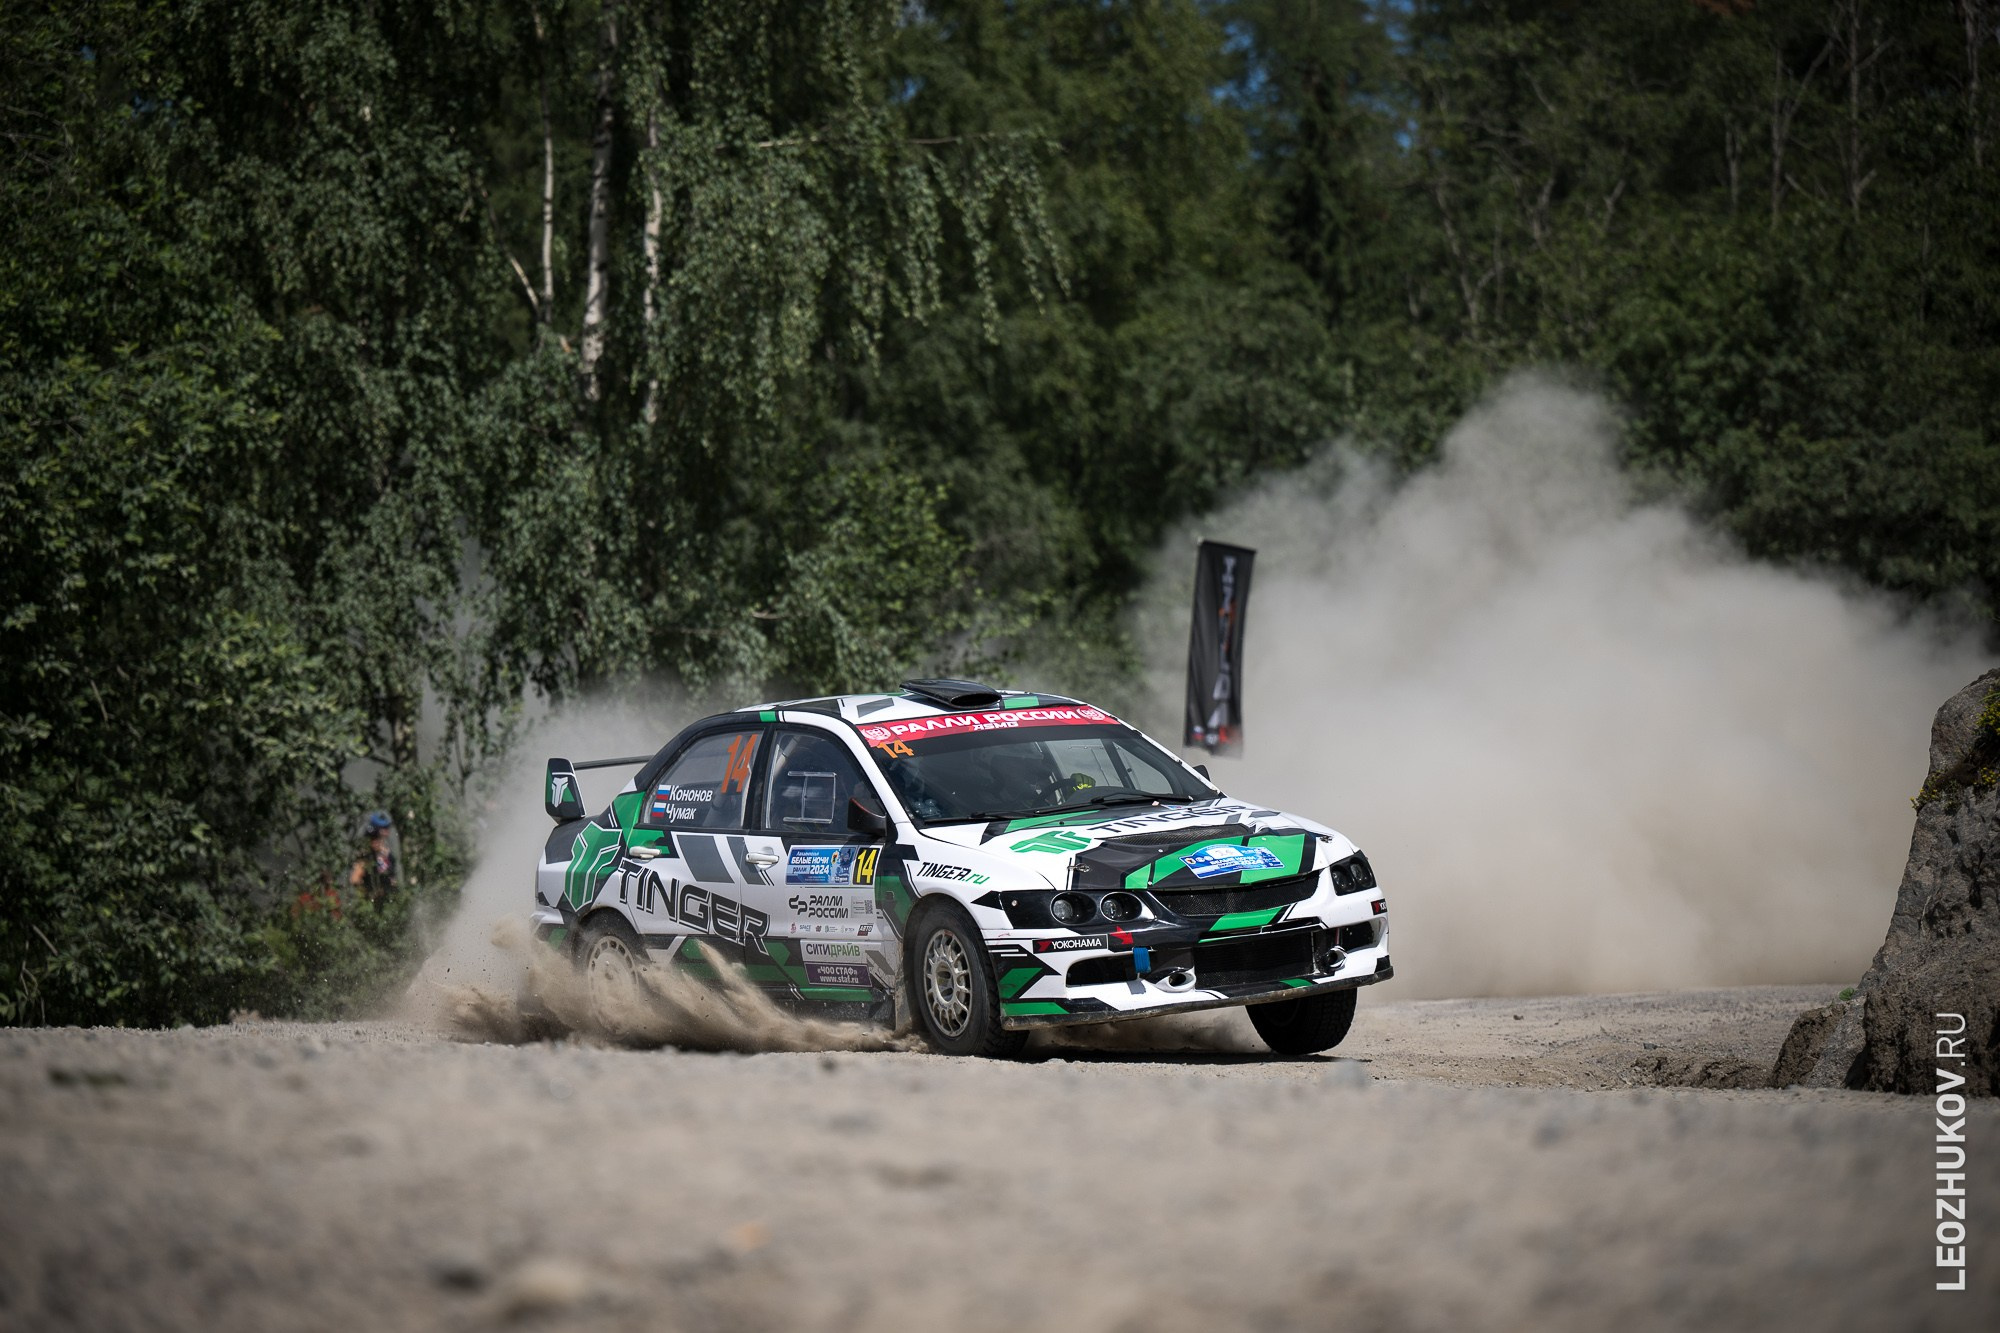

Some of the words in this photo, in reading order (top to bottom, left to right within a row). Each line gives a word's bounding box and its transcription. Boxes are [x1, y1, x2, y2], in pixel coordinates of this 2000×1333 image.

[889, 715, 979, 736] РАЛЛИ
[982, 710, 1081, 723] РОССИИ
[877, 740, 914, 759] 14
[721, 733, 759, 794] 14
[669, 785, 713, 802] Кононов
[665, 803, 697, 823] Чумак
[1086, 805, 1247, 833] TINGER
[809, 864, 830, 875] 2024
[856, 849, 877, 883] 14
[916, 861, 991, 885] TINGER.ru
[617, 857, 771, 956] TINGER
[809, 895, 843, 906] РАЛЛИ
[808, 907, 849, 919] РОССИИ
[806, 943, 860, 958] СИТИДРАЙВ
[1051, 937, 1102, 950] YOKOHAMA
